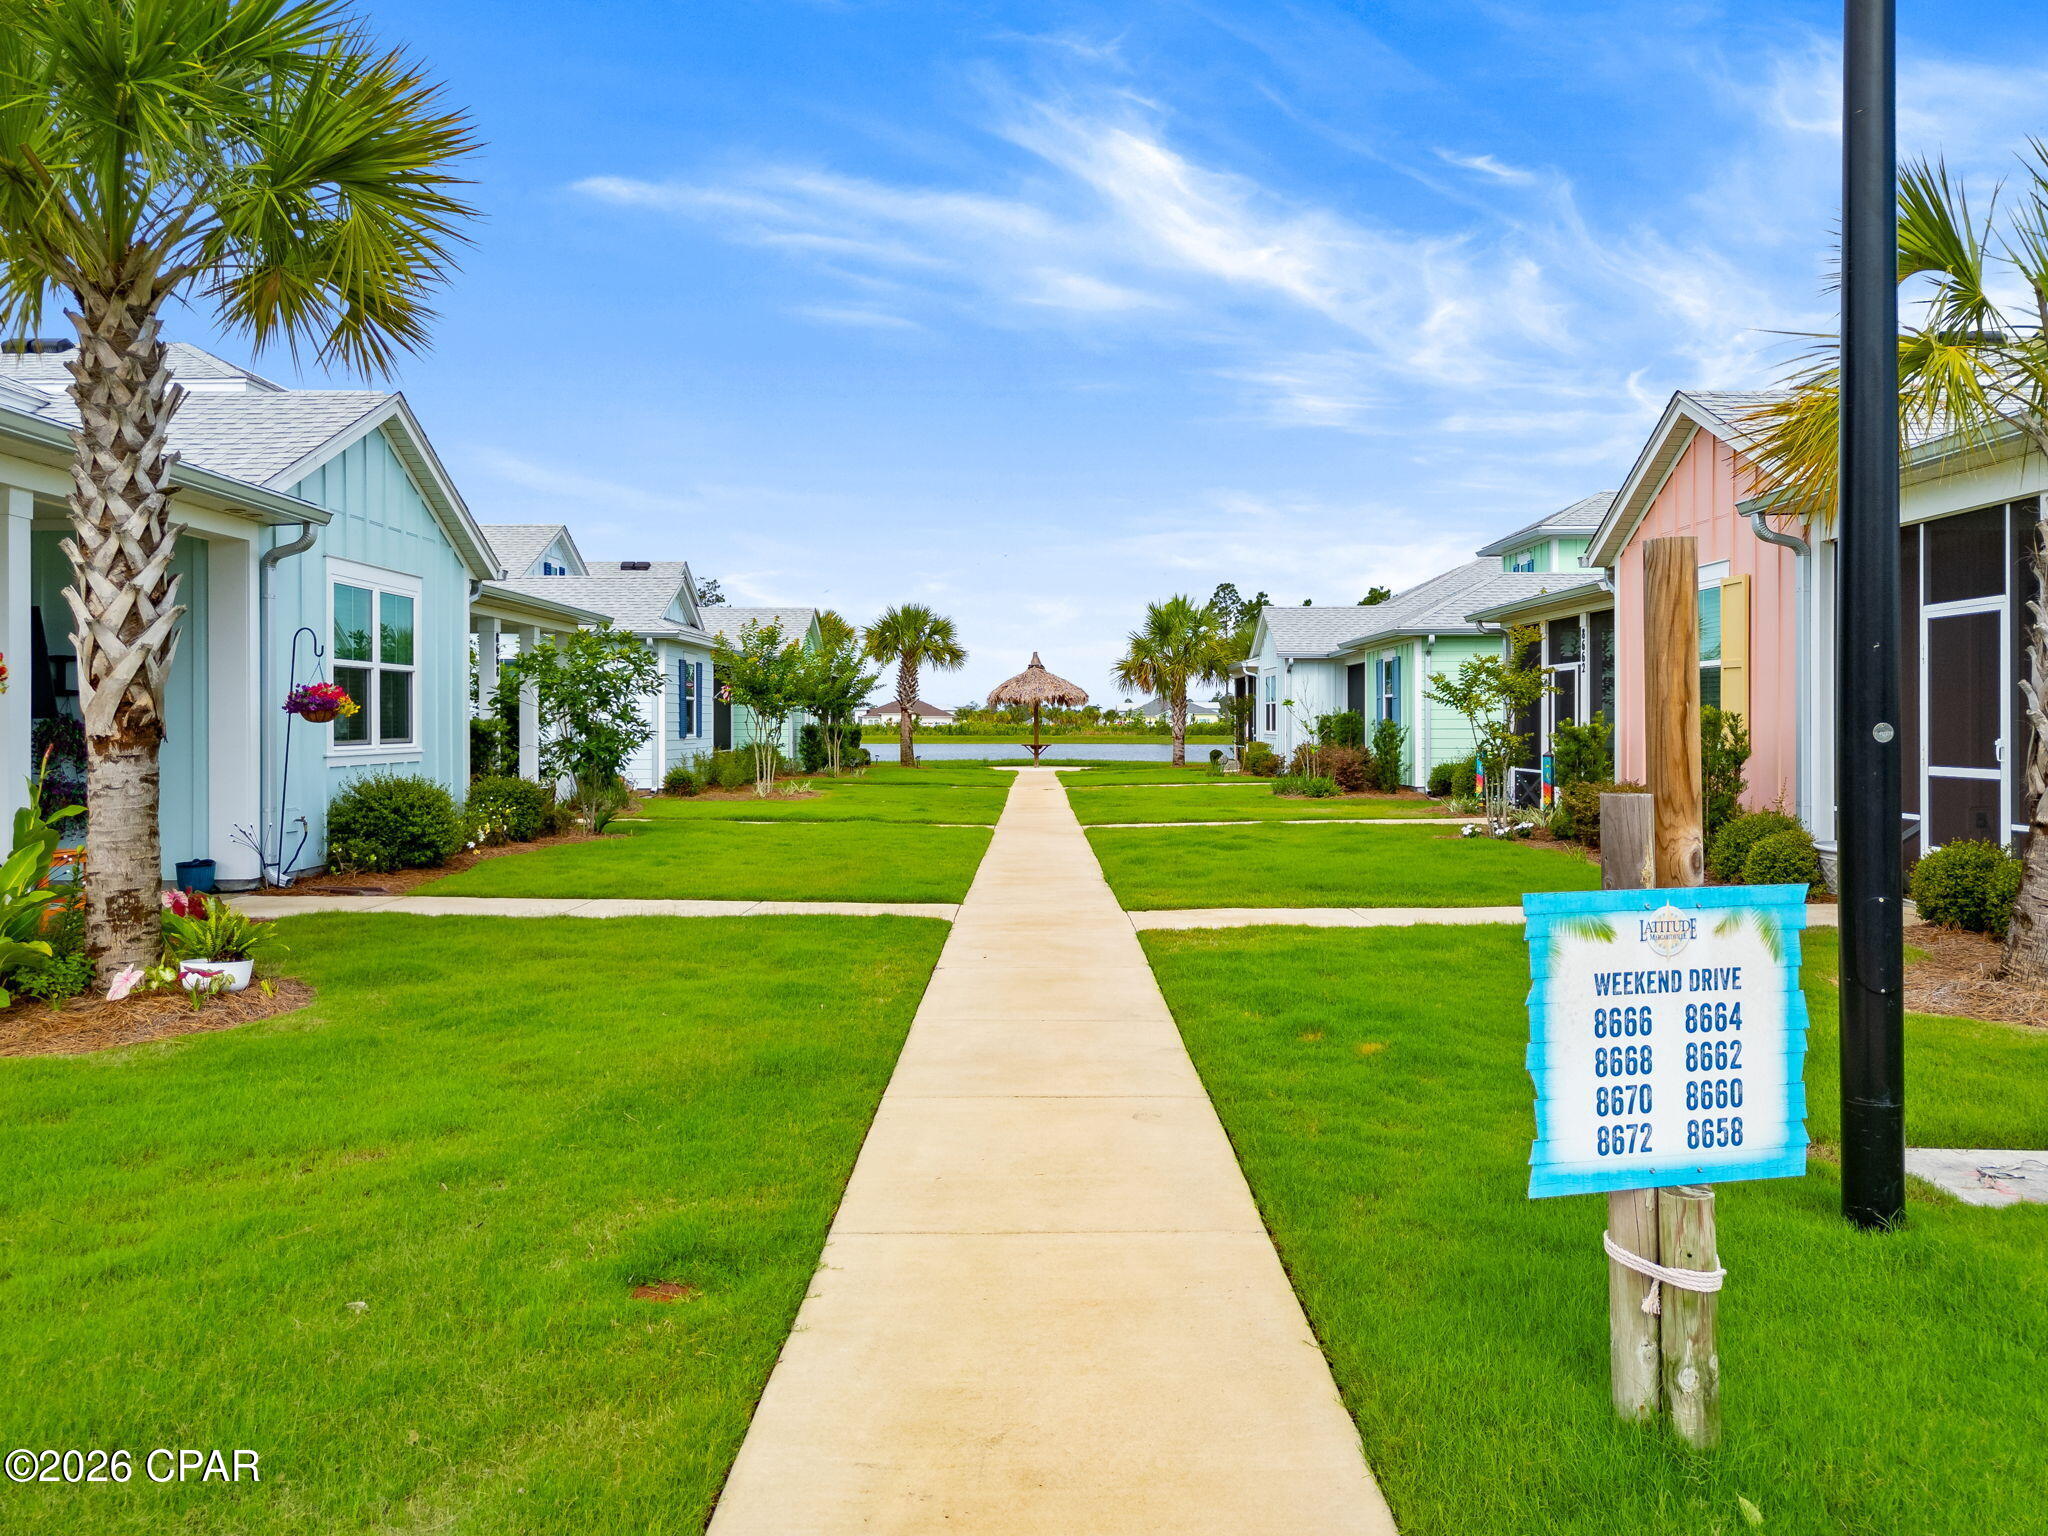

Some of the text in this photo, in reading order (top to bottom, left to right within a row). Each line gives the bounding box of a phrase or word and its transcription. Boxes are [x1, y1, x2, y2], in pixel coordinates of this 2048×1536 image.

[1639, 917, 1697, 942] LATITUDE
[1594, 966, 1742, 996] WEEKEND DRIVE
[1594, 1005, 1652, 1038] 8666
[1685, 1001, 1743, 1033] 8664
[1595, 1044, 1653, 1078] 8668
[1685, 1039, 1742, 1072] 8662
[1596, 1083, 1653, 1117] 8670
[1686, 1078, 1743, 1111] 8660
[1597, 1122, 1653, 1156] 8672
[1687, 1116, 1743, 1150] 8658
